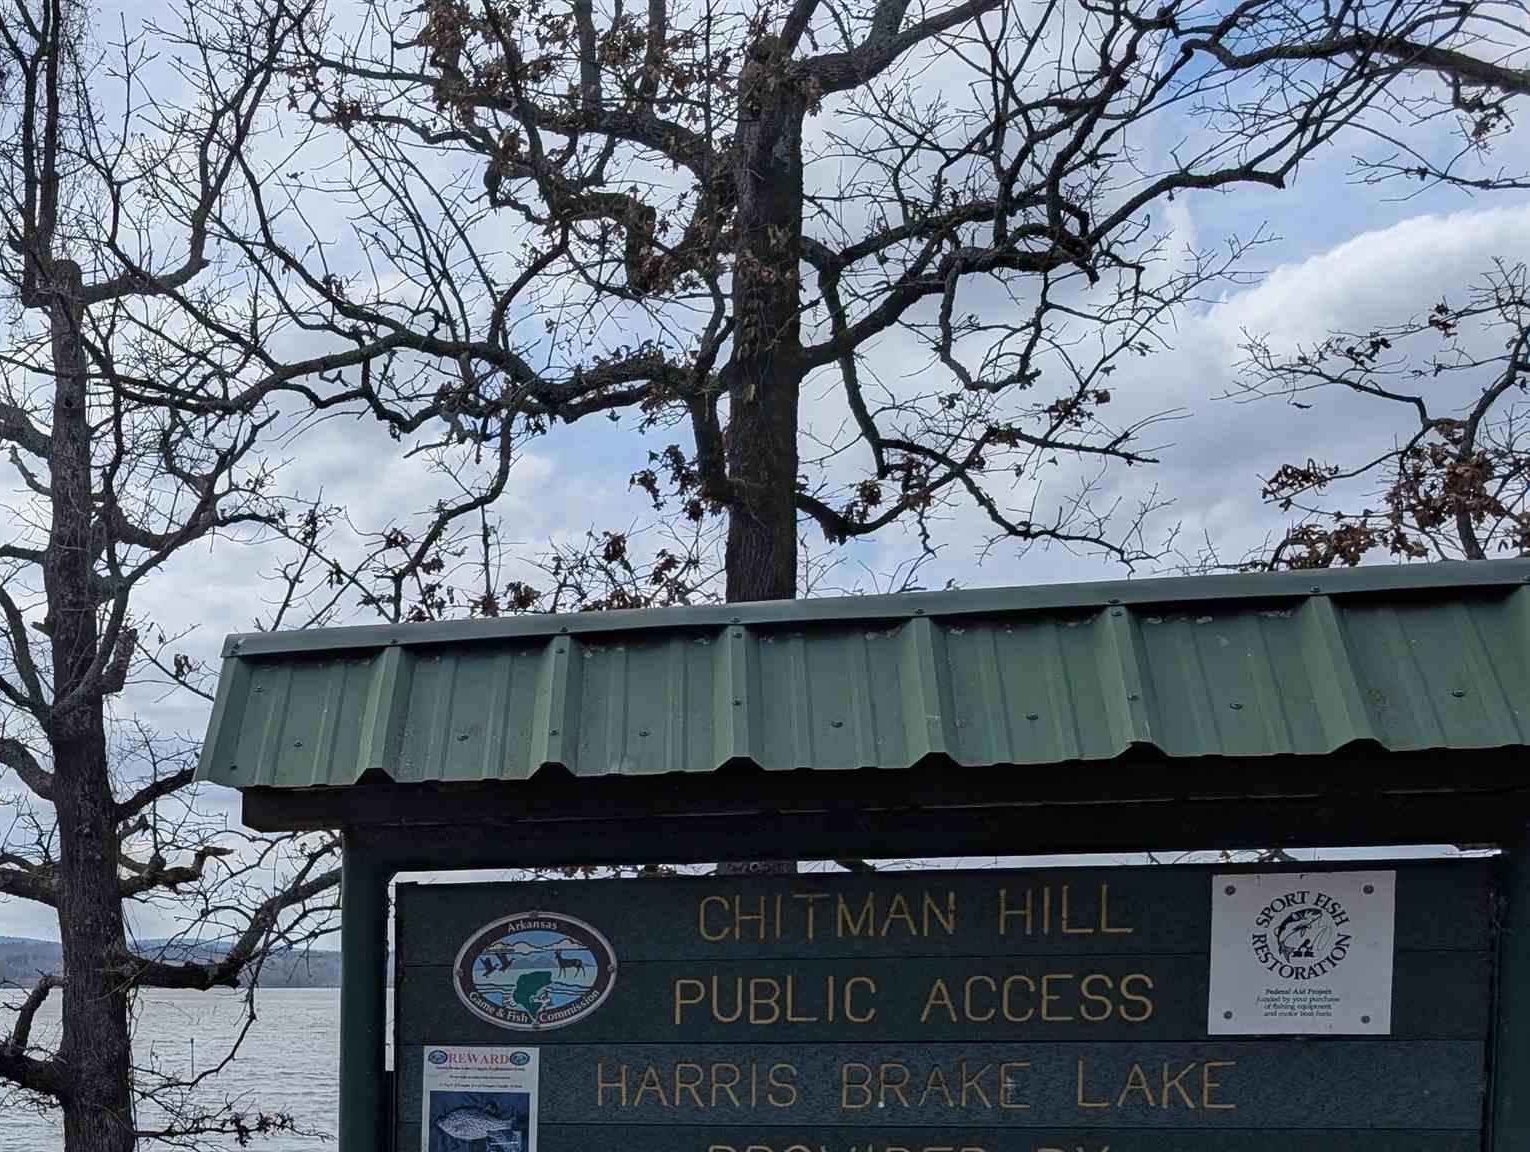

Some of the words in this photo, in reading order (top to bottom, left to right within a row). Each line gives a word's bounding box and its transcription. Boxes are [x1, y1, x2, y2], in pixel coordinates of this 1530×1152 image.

[507, 920, 558, 932] Arkansas
[699, 892, 956, 941] CHITMAN
[998, 884, 1133, 935] HILL
[1256, 891, 1310, 928] SPORT
[1313, 893, 1350, 927] FISH
[1252, 933, 1352, 980] RESTORATION
[469, 991, 496, 1014] Game
[496, 1009, 506, 1018] &
[506, 1011, 529, 1024] Fish
[539, 990, 600, 1023] Commission
[673, 976, 877, 1025] PUBLIC
[921, 974, 1154, 1024] ACCESS
[448, 1052, 510, 1065] REWARD
[597, 1062, 797, 1108] HARRIS
[842, 1062, 1031, 1111] BRAKE
[1077, 1060, 1238, 1110] LAKE
